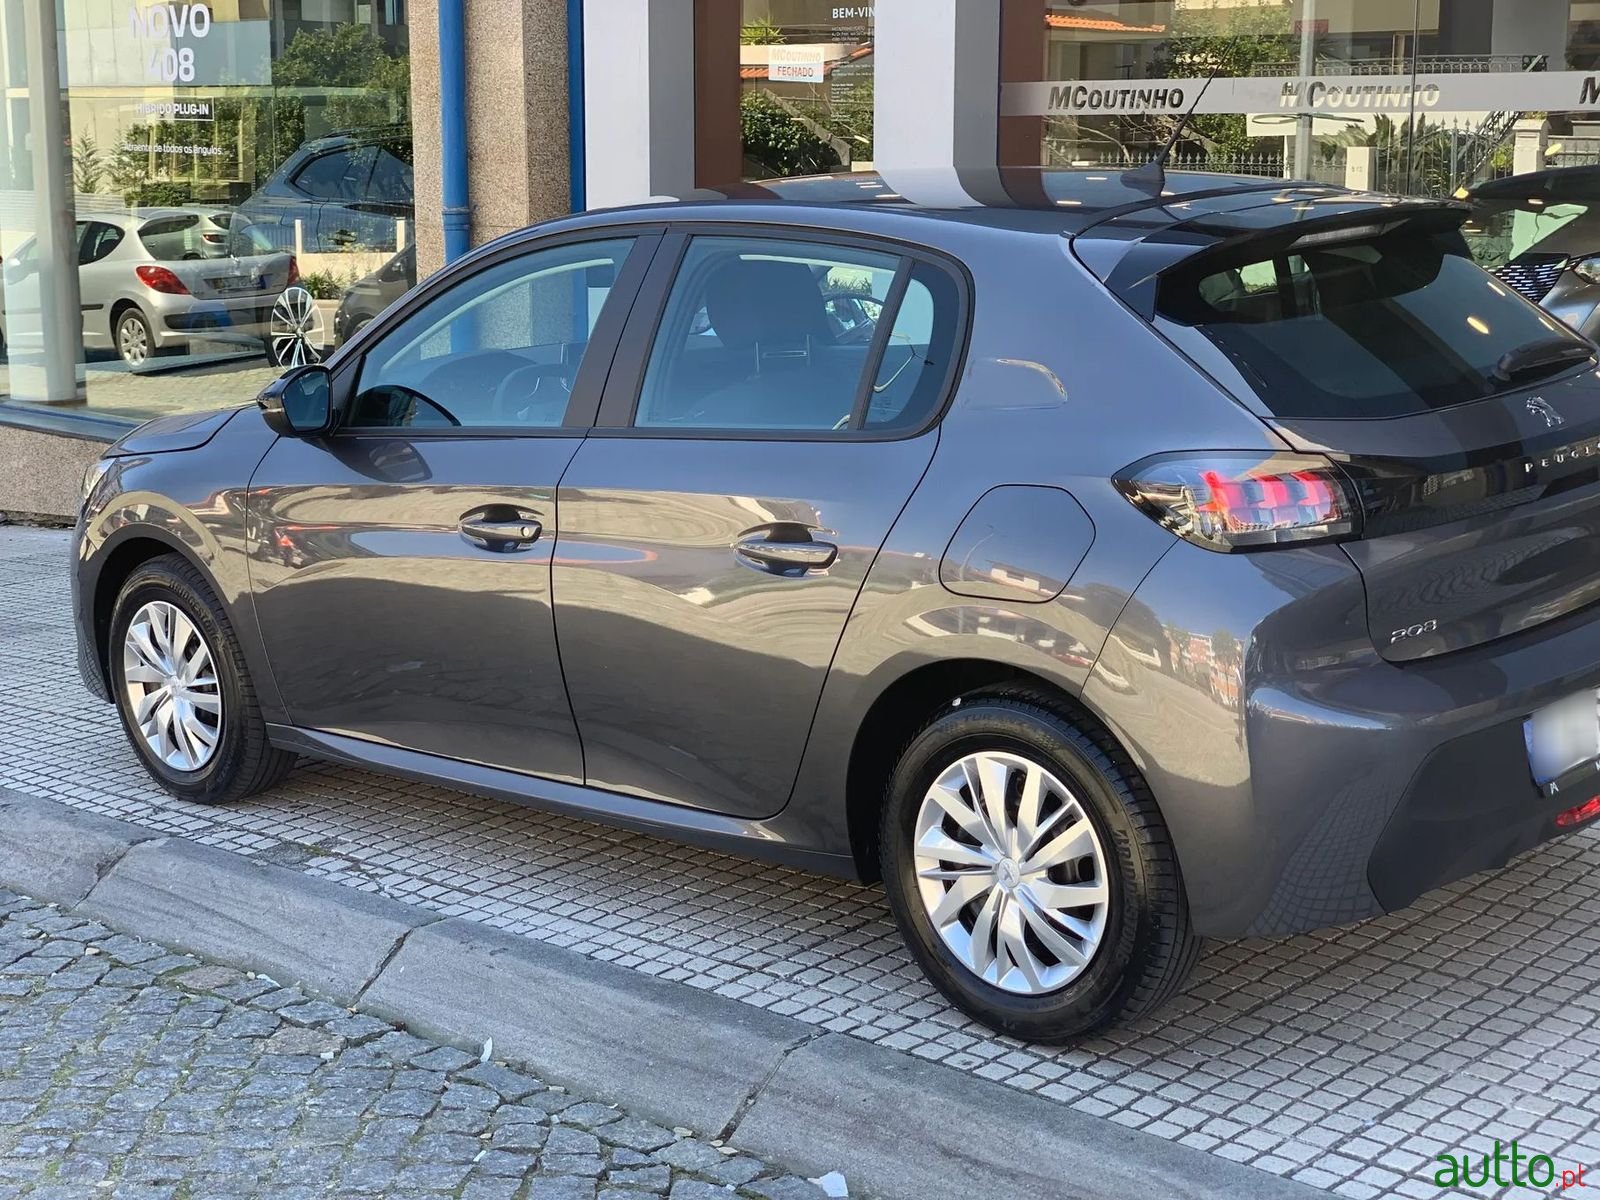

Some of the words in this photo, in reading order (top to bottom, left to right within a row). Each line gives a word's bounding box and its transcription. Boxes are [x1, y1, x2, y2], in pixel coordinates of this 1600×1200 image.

[128, 3, 210, 38] NOVO
[146, 47, 195, 82] 408
[777, 65, 814, 77] FECHADO
[1048, 86, 1184, 110] MCOUTINHO
[1280, 81, 1440, 108] MCOUTINHO
[173, 103, 209, 115] PLUG-IN
[163, 143, 183, 154] todos
[183, 146, 193, 154] os
[1390, 619, 1437, 644] 208
